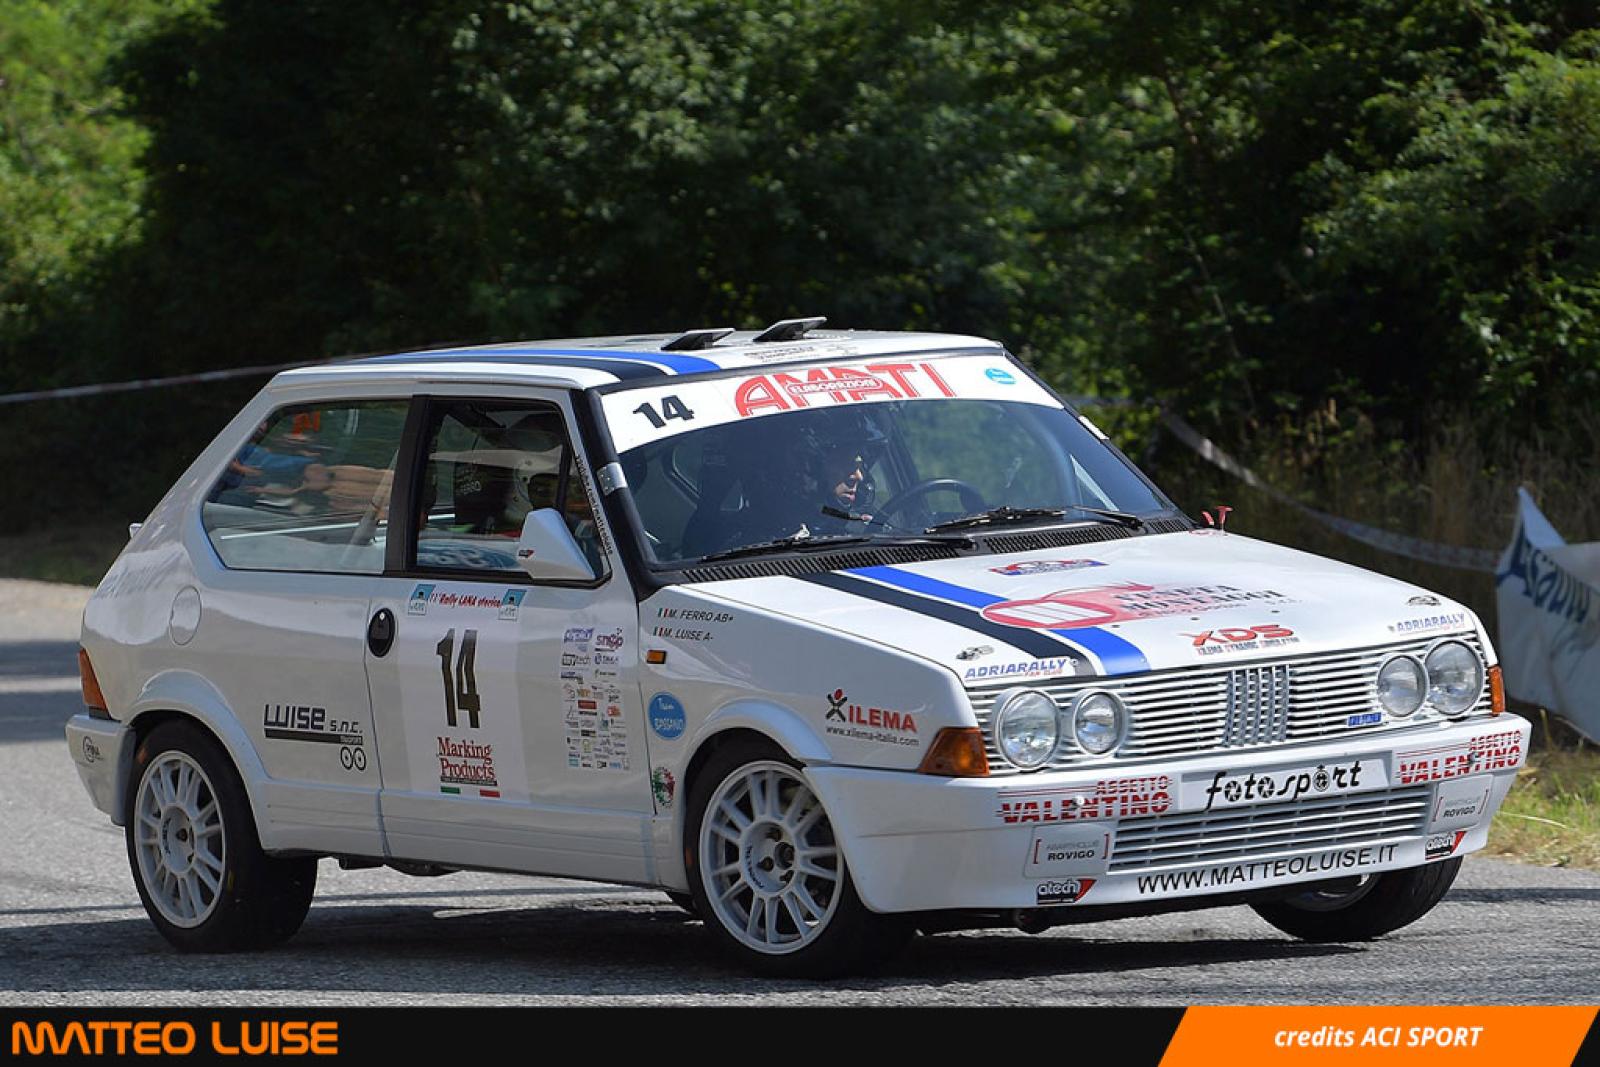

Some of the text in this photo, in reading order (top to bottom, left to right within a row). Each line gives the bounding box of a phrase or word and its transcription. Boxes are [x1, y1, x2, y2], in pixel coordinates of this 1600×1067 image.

[735, 363, 956, 417] AMATI
[633, 394, 694, 428] 14
[668, 608, 678, 619] M.
[680, 609, 713, 621] FERRO
[1397, 613, 1465, 632] ADRIARALLY
[663, 627, 673, 638] M.
[674, 628, 703, 641] LUISE
[1182, 624, 1295, 646] XDS
[436, 628, 481, 729] 14
[965, 658, 1067, 679] ADRIARALLY
[329, 719, 363, 734] s.n.c.
[437, 737, 492, 765] Marking
[1469, 729, 1522, 752] ASSETTO
[439, 757, 496, 781] Products
[1399, 745, 1521, 784] VALENTINO
[1096, 775, 1172, 795] ASSETTO
[1203, 760, 1362, 812] fotosport
[999, 791, 1172, 824] VALENTINO
[1443, 805, 1476, 818] ROVIGO
[1047, 849, 1095, 861] ROVIGO
[1137, 842, 1399, 895] WWW.MATTEOLUISE.IT
[1037, 878, 1078, 896] atech
